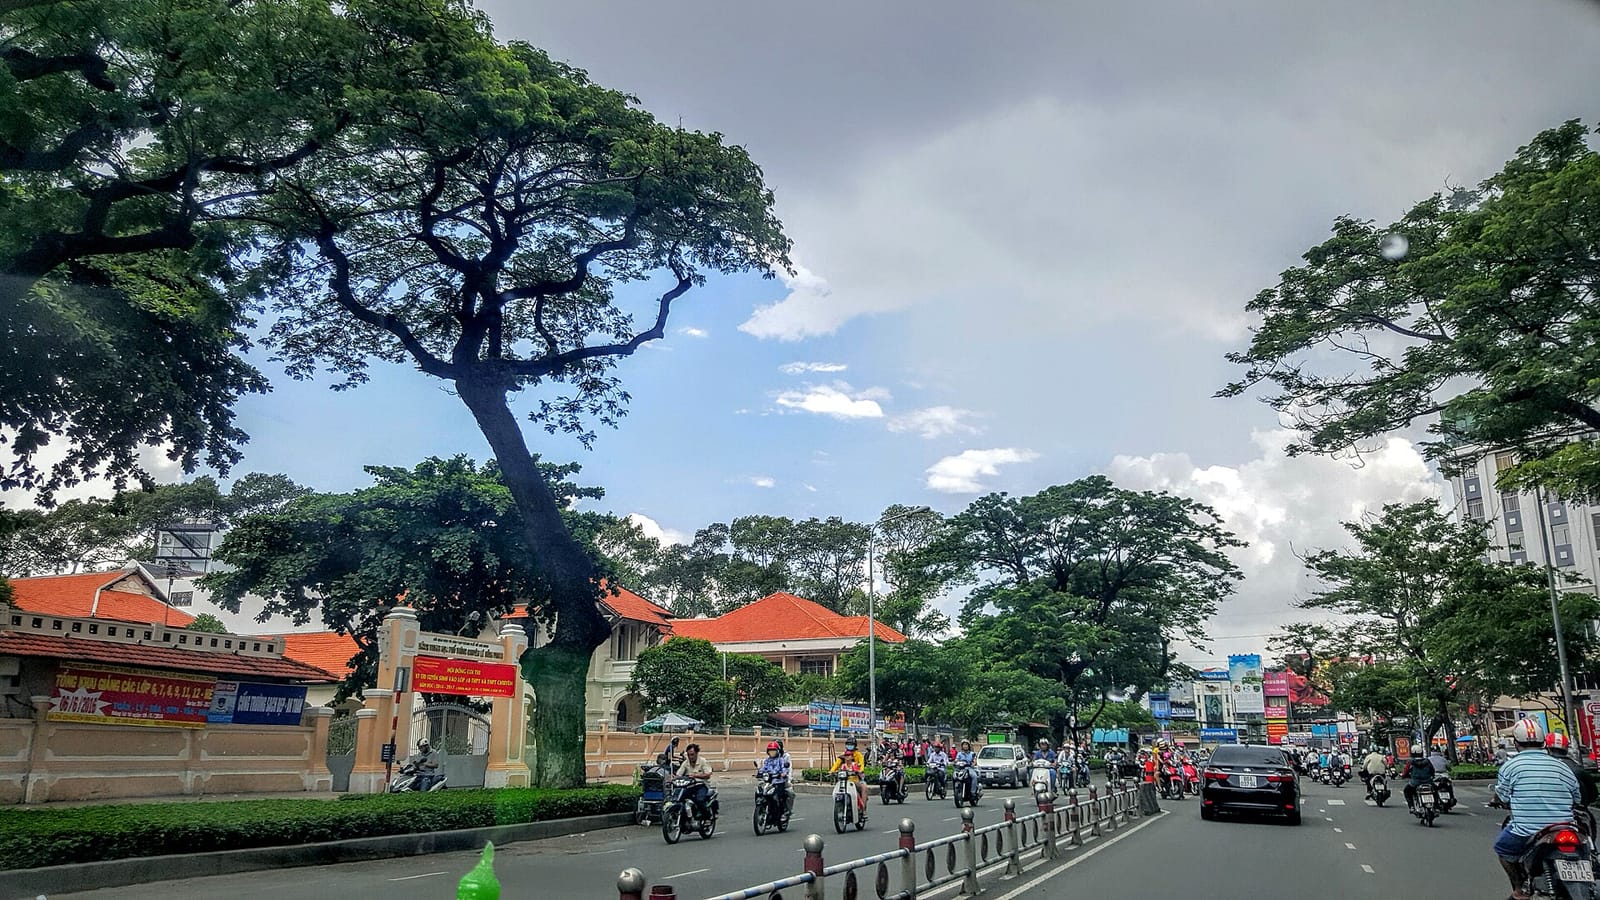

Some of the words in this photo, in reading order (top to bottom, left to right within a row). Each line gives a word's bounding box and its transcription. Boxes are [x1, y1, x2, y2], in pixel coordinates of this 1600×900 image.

[56, 669, 78, 689] TỔNG
[79, 676, 98, 690] KHAI
[98, 674, 121, 692] GIẢNG
[121, 678, 136, 693] CÁC
[136, 679, 151, 694] LỚP
[1561, 870, 1592, 880] 091.45
